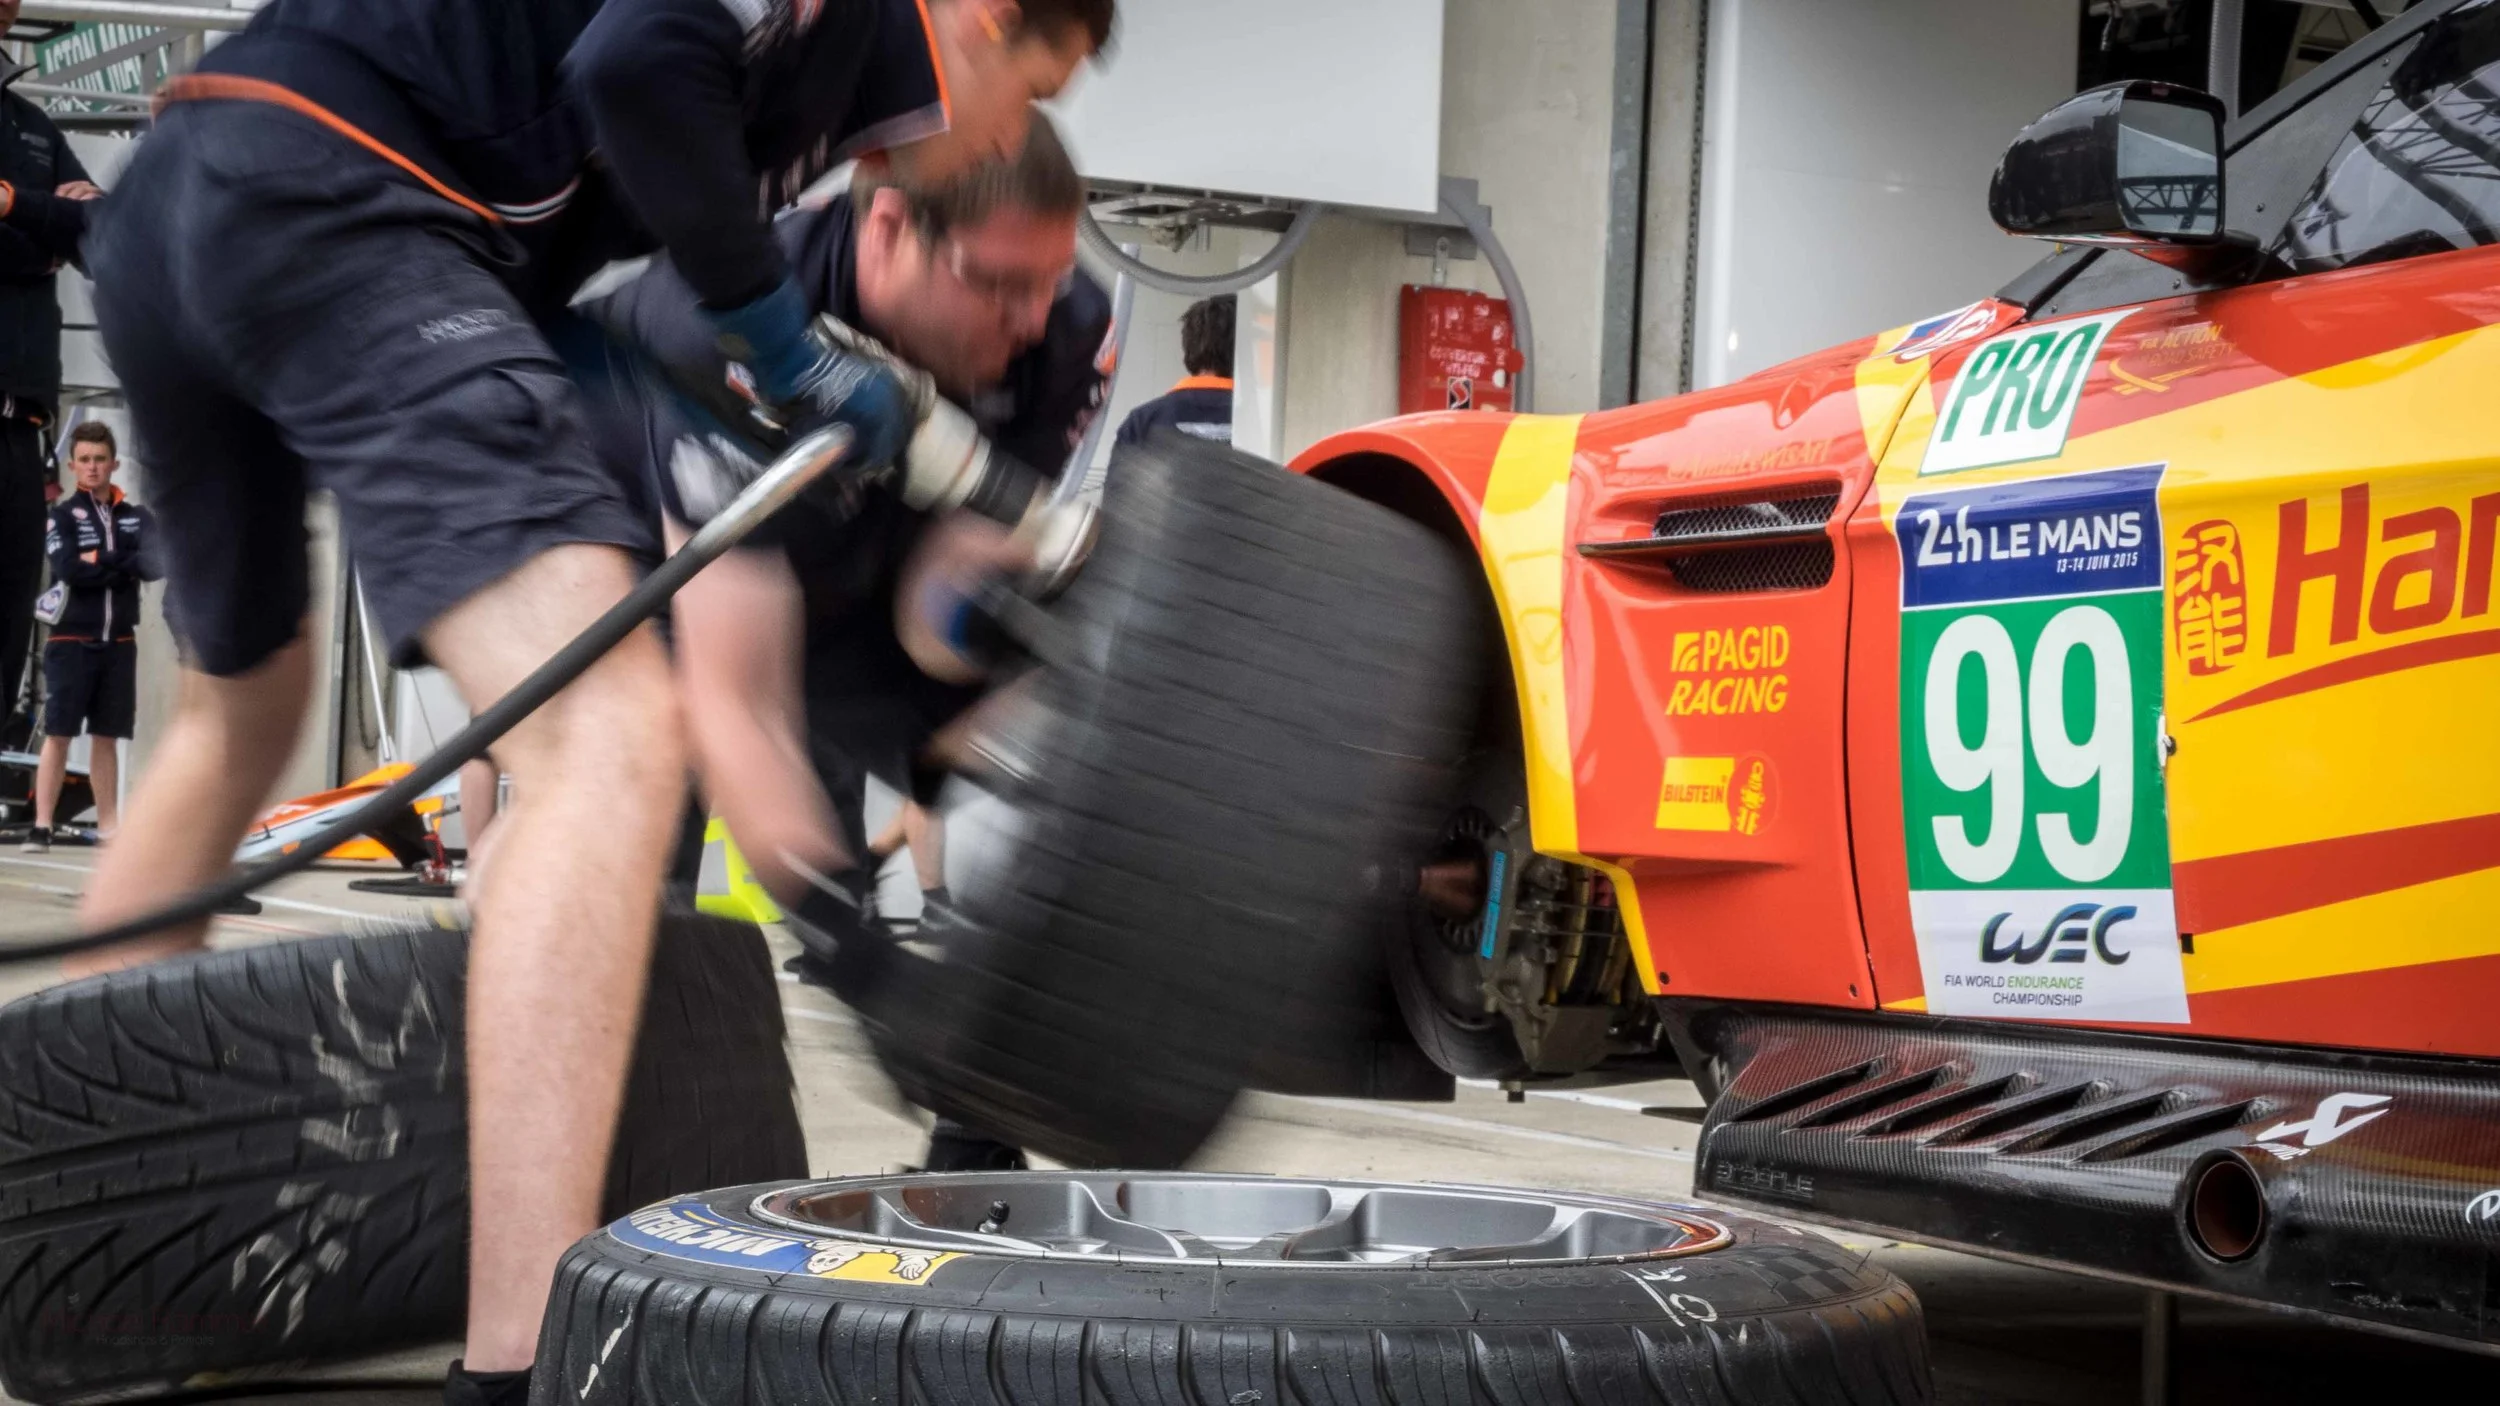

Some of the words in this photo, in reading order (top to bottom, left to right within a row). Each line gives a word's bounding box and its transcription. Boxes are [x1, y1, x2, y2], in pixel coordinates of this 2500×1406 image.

[2160, 325, 2223, 349] ACTION
[1940, 322, 2103, 442] PRO
[1917, 505, 1982, 567] 24h
[1989, 523, 2030, 560] LE
[2038, 512, 2142, 555] MANS
[2056, 558, 2084, 574] 13-14
[2087, 555, 2111, 571] JUIN
[2113, 552, 2138, 569] 2015
[1703, 625, 1789, 671] PAGID
[1665, 675, 1789, 716] RACING
[1924, 605, 2134, 883] 99
[1664, 780, 1725, 804] BILSTEIN
[1979, 902, 2138, 965] WEC
[1944, 974, 1962, 987] FIA
[1965, 975, 2005, 988] WORLD
[2007, 975, 2084, 990] ENDURANCE
[1993, 991, 2083, 1006] CHAMPIONSHIP
